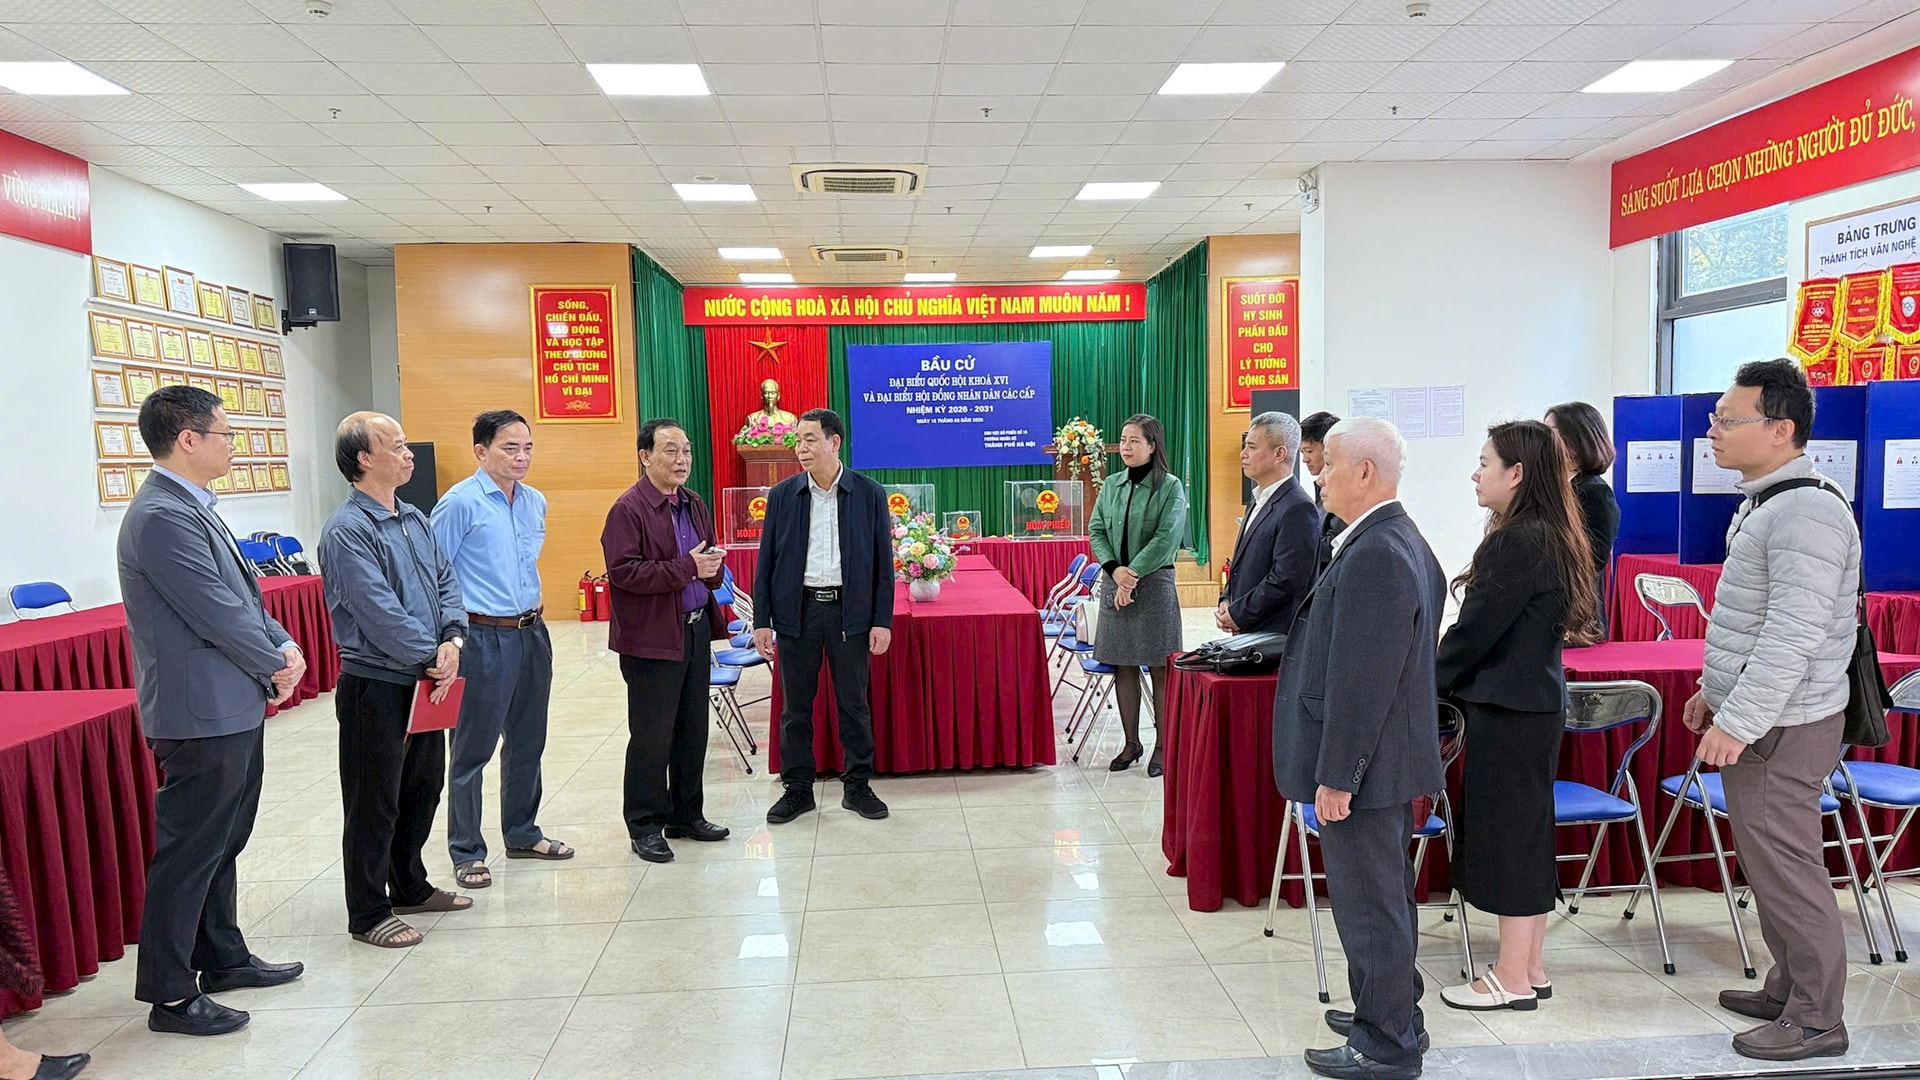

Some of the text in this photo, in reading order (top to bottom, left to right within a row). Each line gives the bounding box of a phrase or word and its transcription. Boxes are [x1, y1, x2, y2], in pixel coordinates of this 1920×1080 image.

[1621, 93, 1915, 216] SÁNG SUỐT LỰA CHỌN NHỮNG NGƯỜI ĐỦ ĐỨC,
[1837, 216, 1916, 245] BẢNG TRƯNG
[1820, 235, 1916, 266] THÀNH TÍCH VĂN NGHỆ
[1240, 290, 1285, 305] SUỐT ĐỜI
[557, 298, 589, 311] SỐNG,
[704, 294, 747, 317] NƯỚC
[750, 295, 793, 320] CỘNG
[796, 295, 826, 316] HOÀ
[830, 295, 851, 316] XÃ
[855, 295, 879, 320] HỘI
[883, 291, 913, 316] CHỦ
[917, 294, 962, 316] NGHĨA
[966, 293, 997, 318] VIỆT
[1001, 295, 1035, 315] NAM
[1039, 292, 1082, 314] MUÔN
[1087, 291, 1120, 313] NĂM
[545, 310, 602, 323] CHIẾN ĐẤU,
[1243, 310, 1282, 321] HY SINH
[571, 324, 600, 335] ĐỘNG
[1238, 322, 1288, 337] PHẤN ĐẤU
[545, 336, 604, 348] VÀ HỌC TẬP
[1253, 342, 1273, 353] CHO
[544, 349, 607, 359] THEO GƯƠNG
[553, 360, 599, 373] CHỦ TỊCH
[921, 354, 976, 371] BẦU CỬ
[1240, 354, 1287, 370] LÝ TƯỞNG
[545, 373, 609, 384] HỒ CHÍ MINH
[889, 372, 1009, 389] ĐẠI BIỂU QUỐC HỘI KHOÁ XVI
[1238, 370, 1288, 388] CỘNG SẢN
[562, 386, 593, 397] VĨ ĐẠI
[863, 386, 1035, 404] VÀ ĐẠI BIỂU HỘI ĐỒNG NHÂN DÂN CÁC CẤP
[906, 405, 933, 416] NHIỆM
[935, 404, 946, 414] KỲ
[948, 405, 968, 413] 2026
[974, 405, 993, 413] 2031
[736, 527, 757, 538] HÒM
